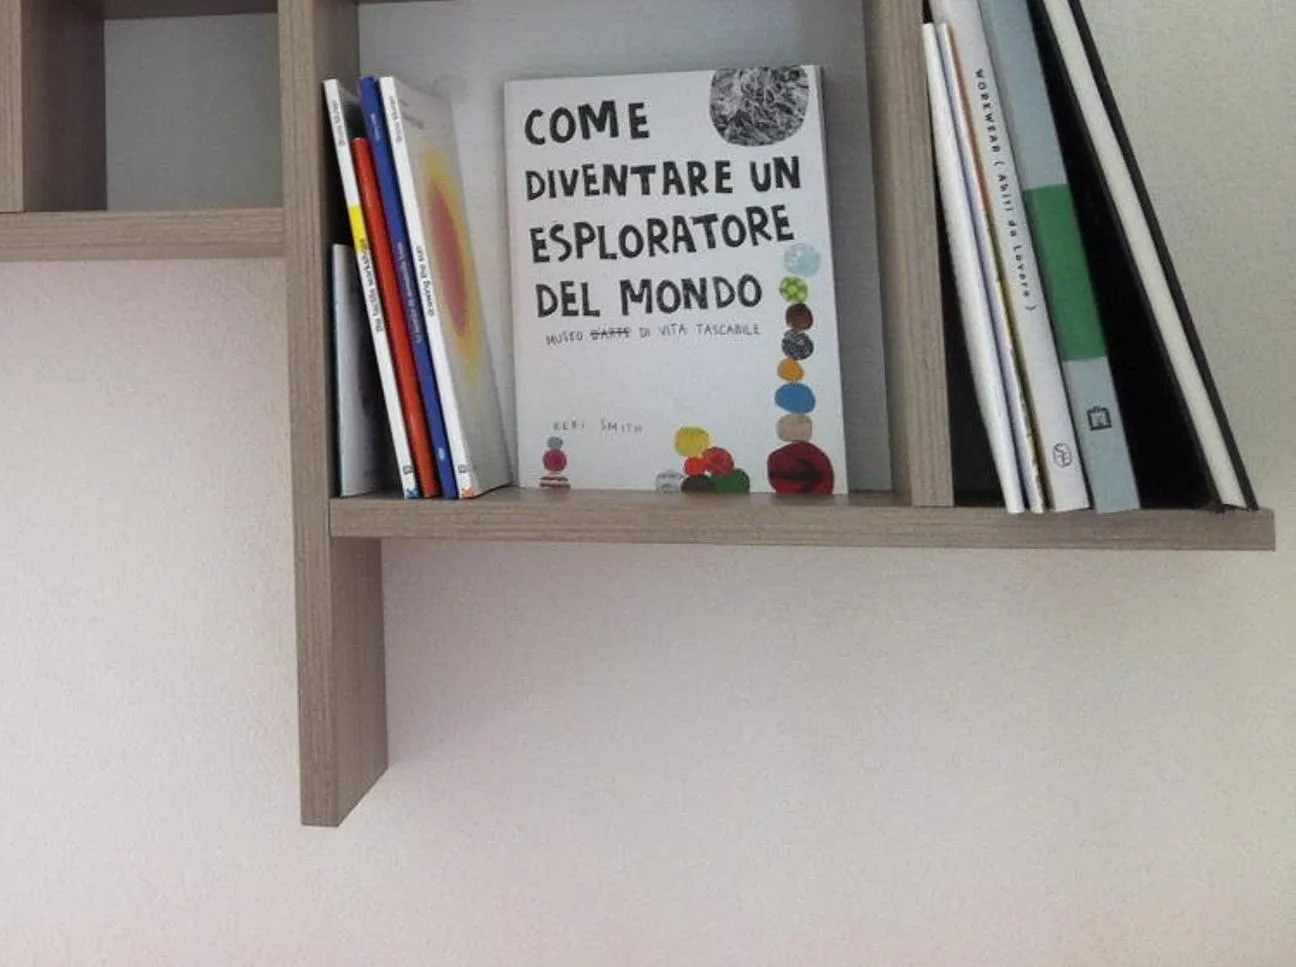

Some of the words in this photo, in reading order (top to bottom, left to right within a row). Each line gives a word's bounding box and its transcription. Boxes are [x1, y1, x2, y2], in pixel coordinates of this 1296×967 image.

[524, 100, 649, 145] COME
[975, 68, 1001, 153] WORKWEAR
[525, 160, 733, 200] DIVENTARE
[749, 156, 801, 193] UN
[530, 204, 795, 263] ESPLORATORE
[536, 280, 600, 318] DEL
[620, 274, 763, 315] MONDO
[546, 331, 583, 345] MUSEO
[639, 327, 651, 338] DI
[659, 323, 687, 337] VITA
[696, 323, 761, 336] TASCABILE
